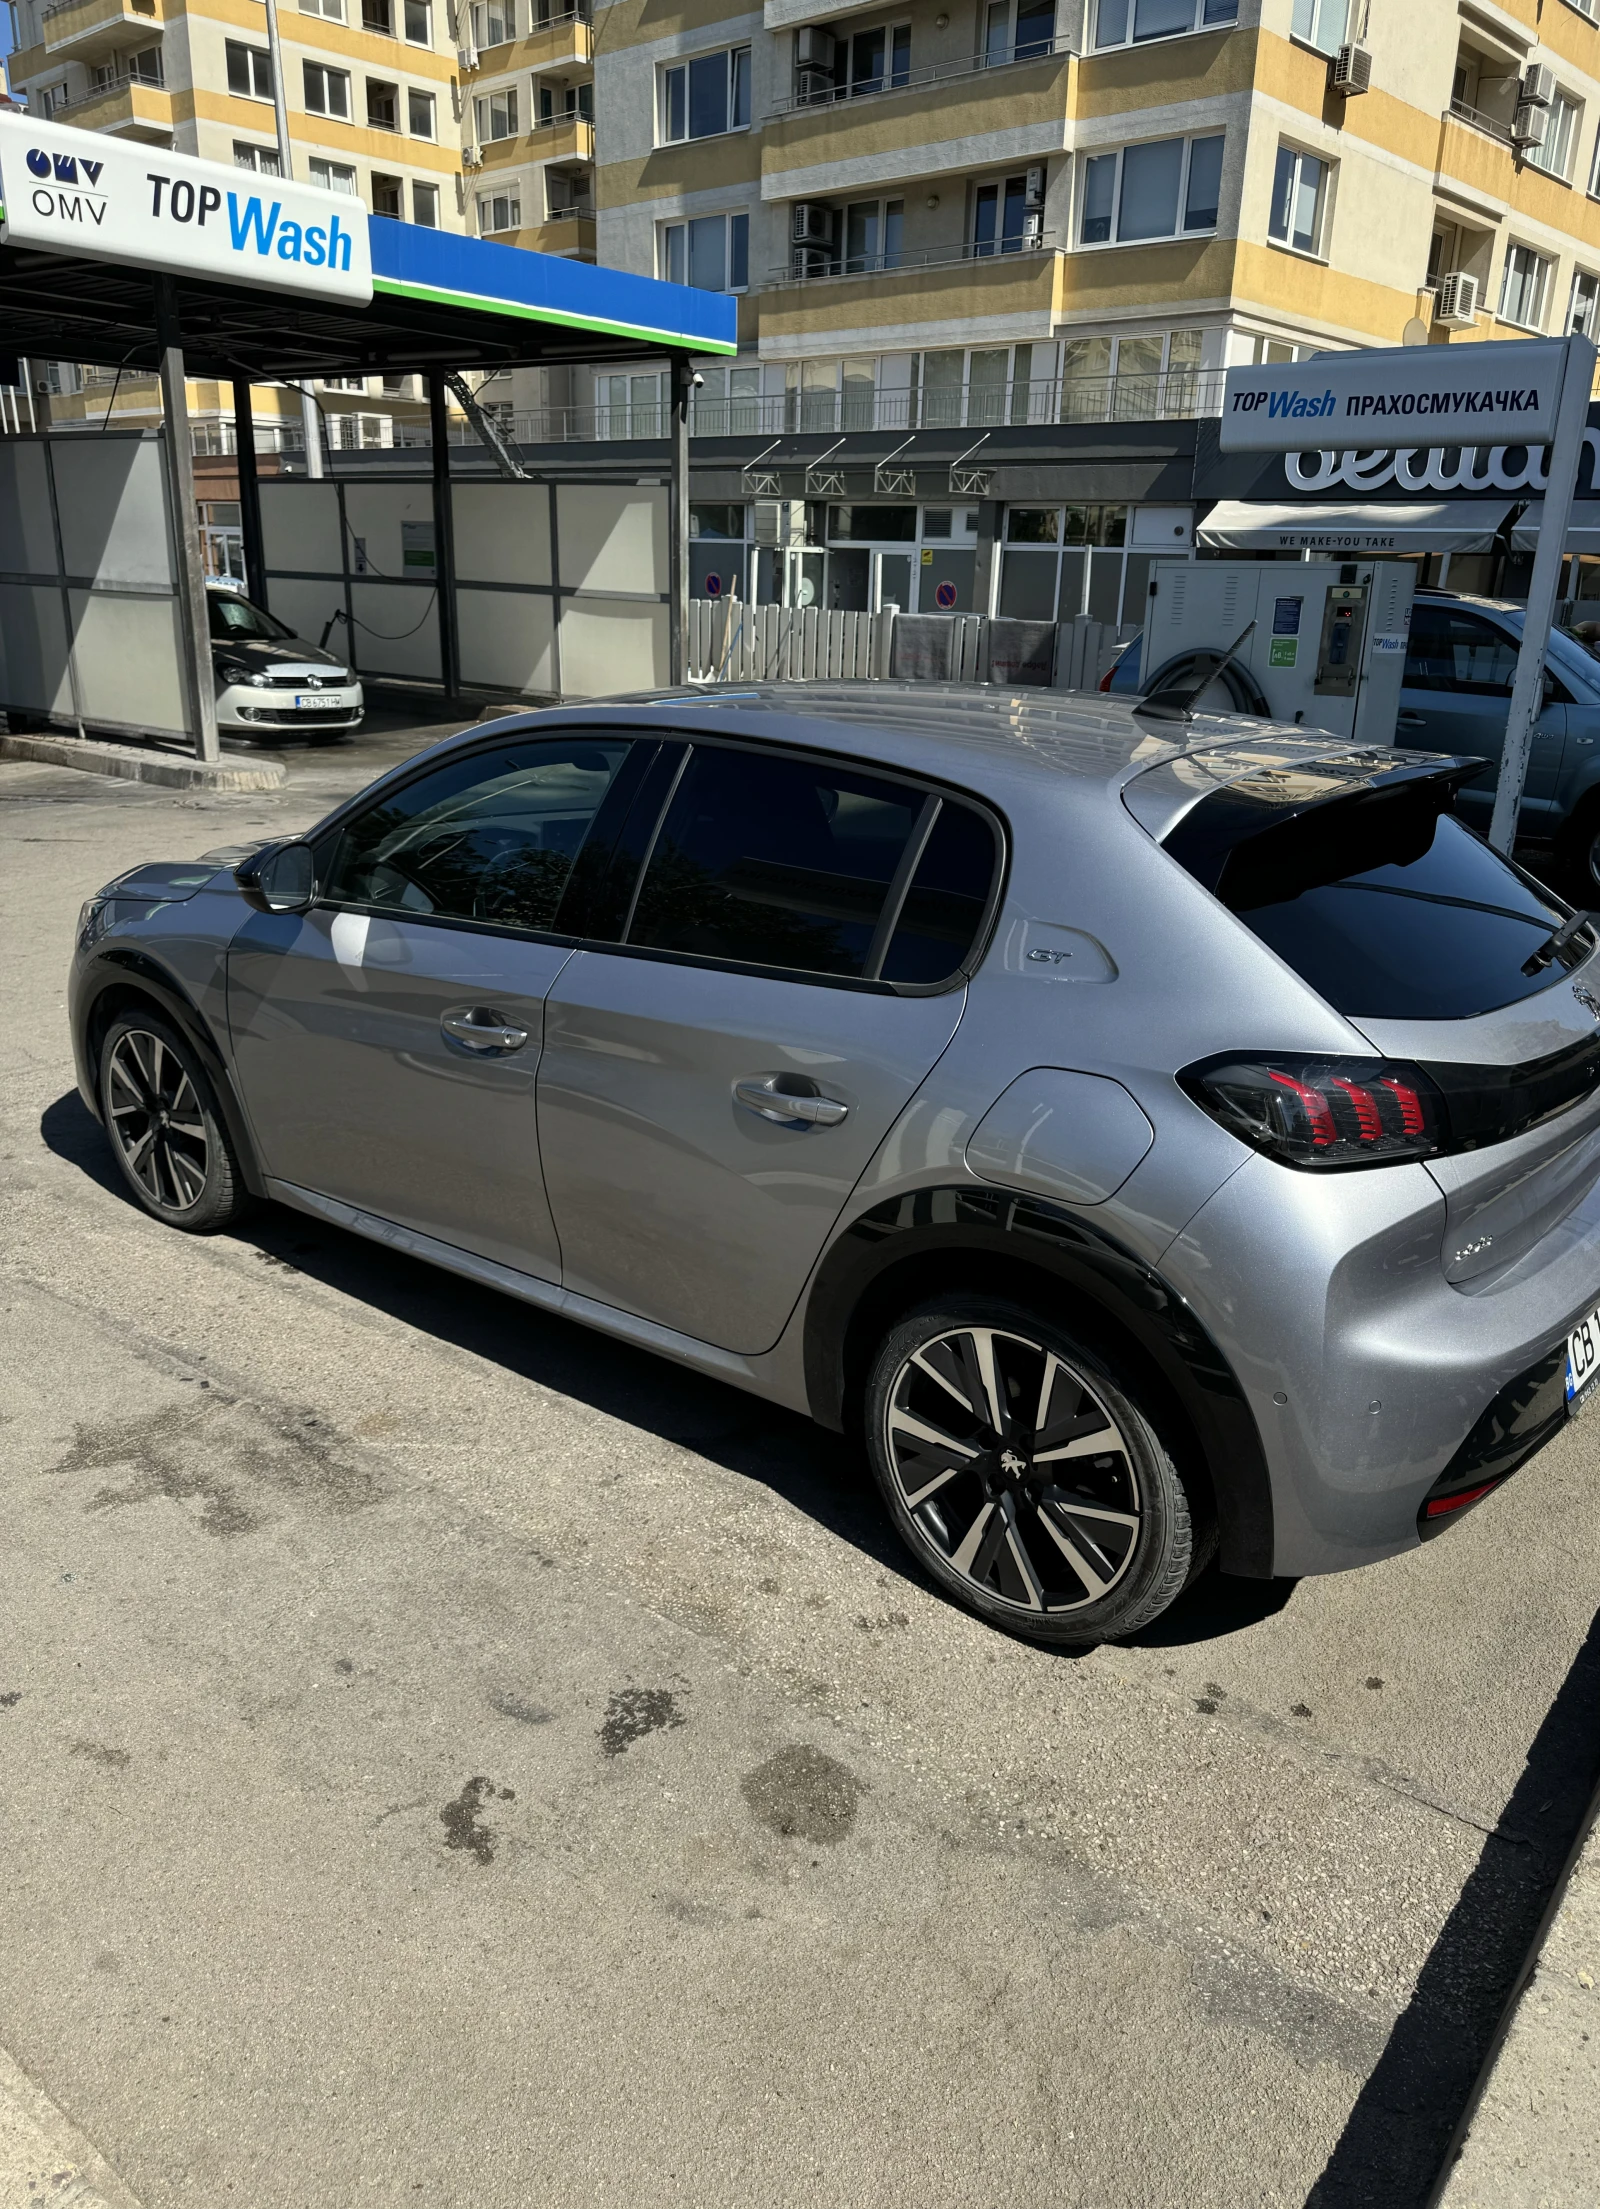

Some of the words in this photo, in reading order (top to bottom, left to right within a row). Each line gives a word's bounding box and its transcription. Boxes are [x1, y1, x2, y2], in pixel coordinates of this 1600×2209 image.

[32, 189, 107, 225] OMV
[1346, 389, 1540, 416] ПРАХОСМУКАЧКА
[1279, 536, 1295, 546] WE
[1365, 537, 1395, 547] TAKE
[1026, 948, 1073, 964] GT
